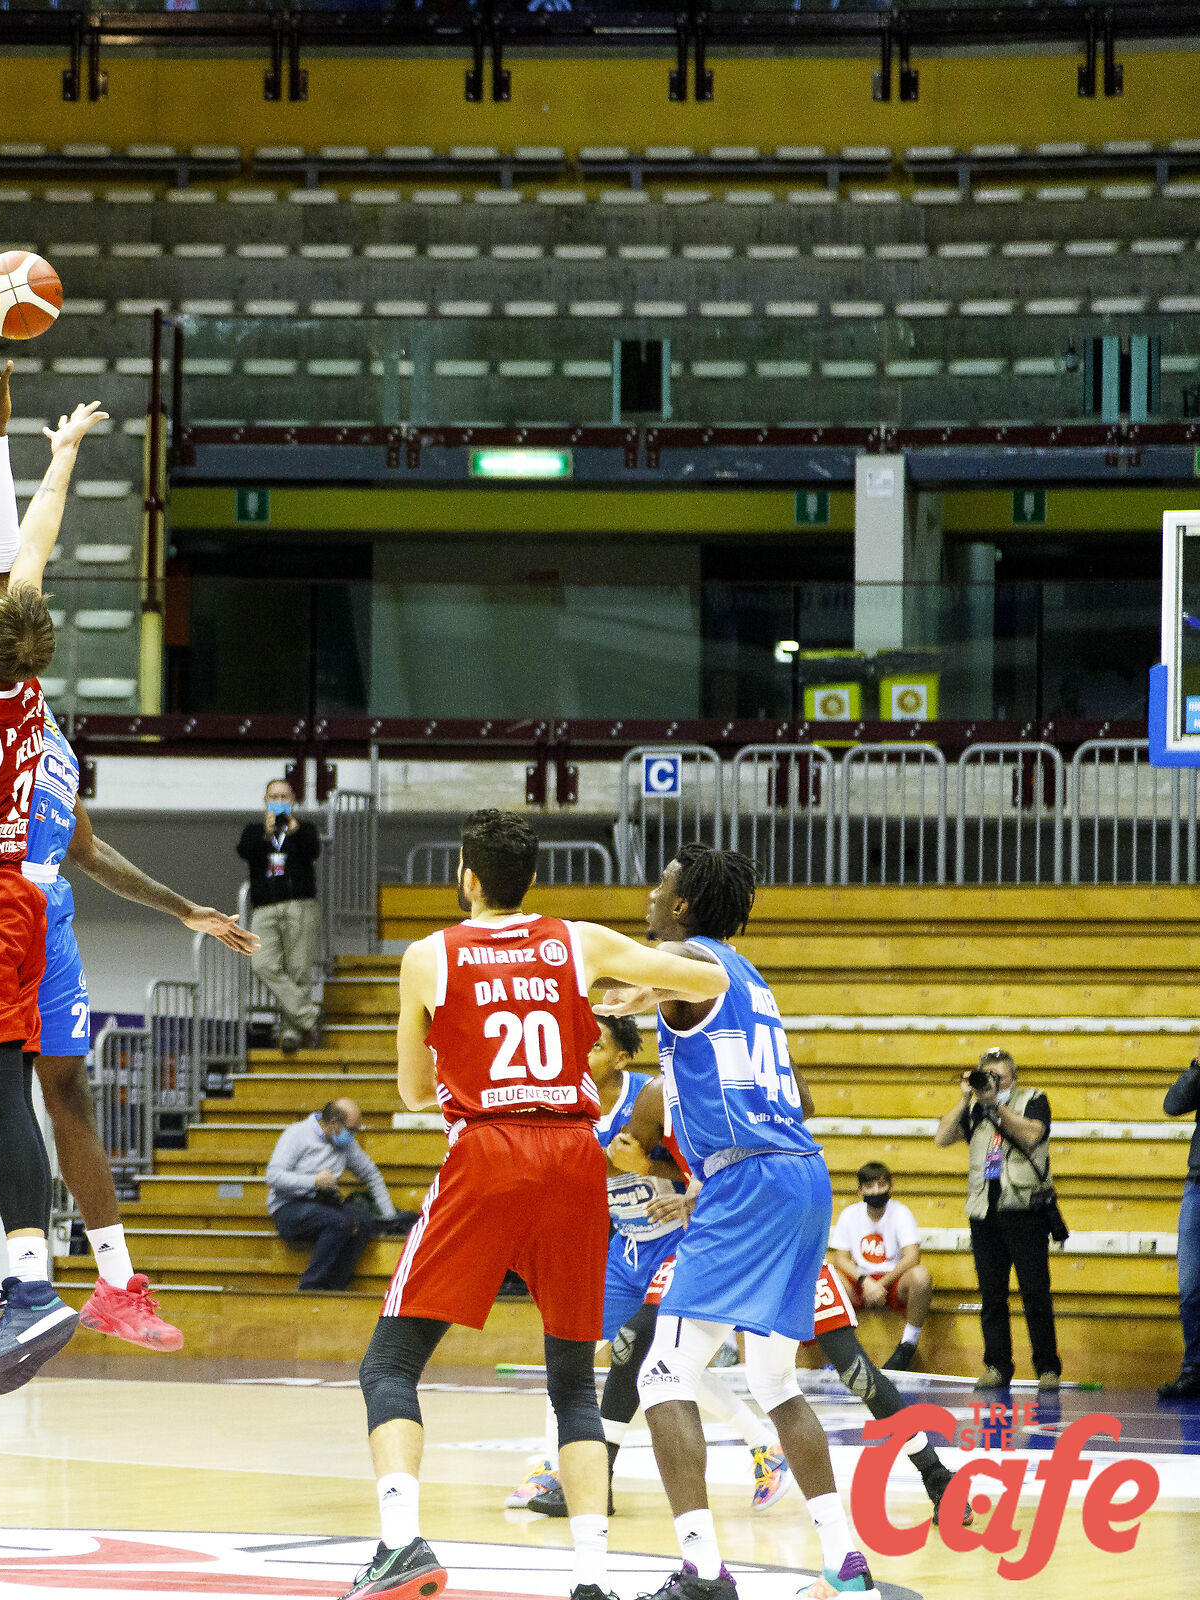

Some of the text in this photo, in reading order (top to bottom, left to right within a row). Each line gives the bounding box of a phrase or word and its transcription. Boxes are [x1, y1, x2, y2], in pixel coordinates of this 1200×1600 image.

[650, 760, 675, 791] C
[457, 946, 537, 967] Allianz
[474, 976, 560, 1006] DA ROS
[483, 1010, 564, 1081] 20
[751, 1022, 802, 1109] 45
[487, 1088, 571, 1104] BLUENERGY
